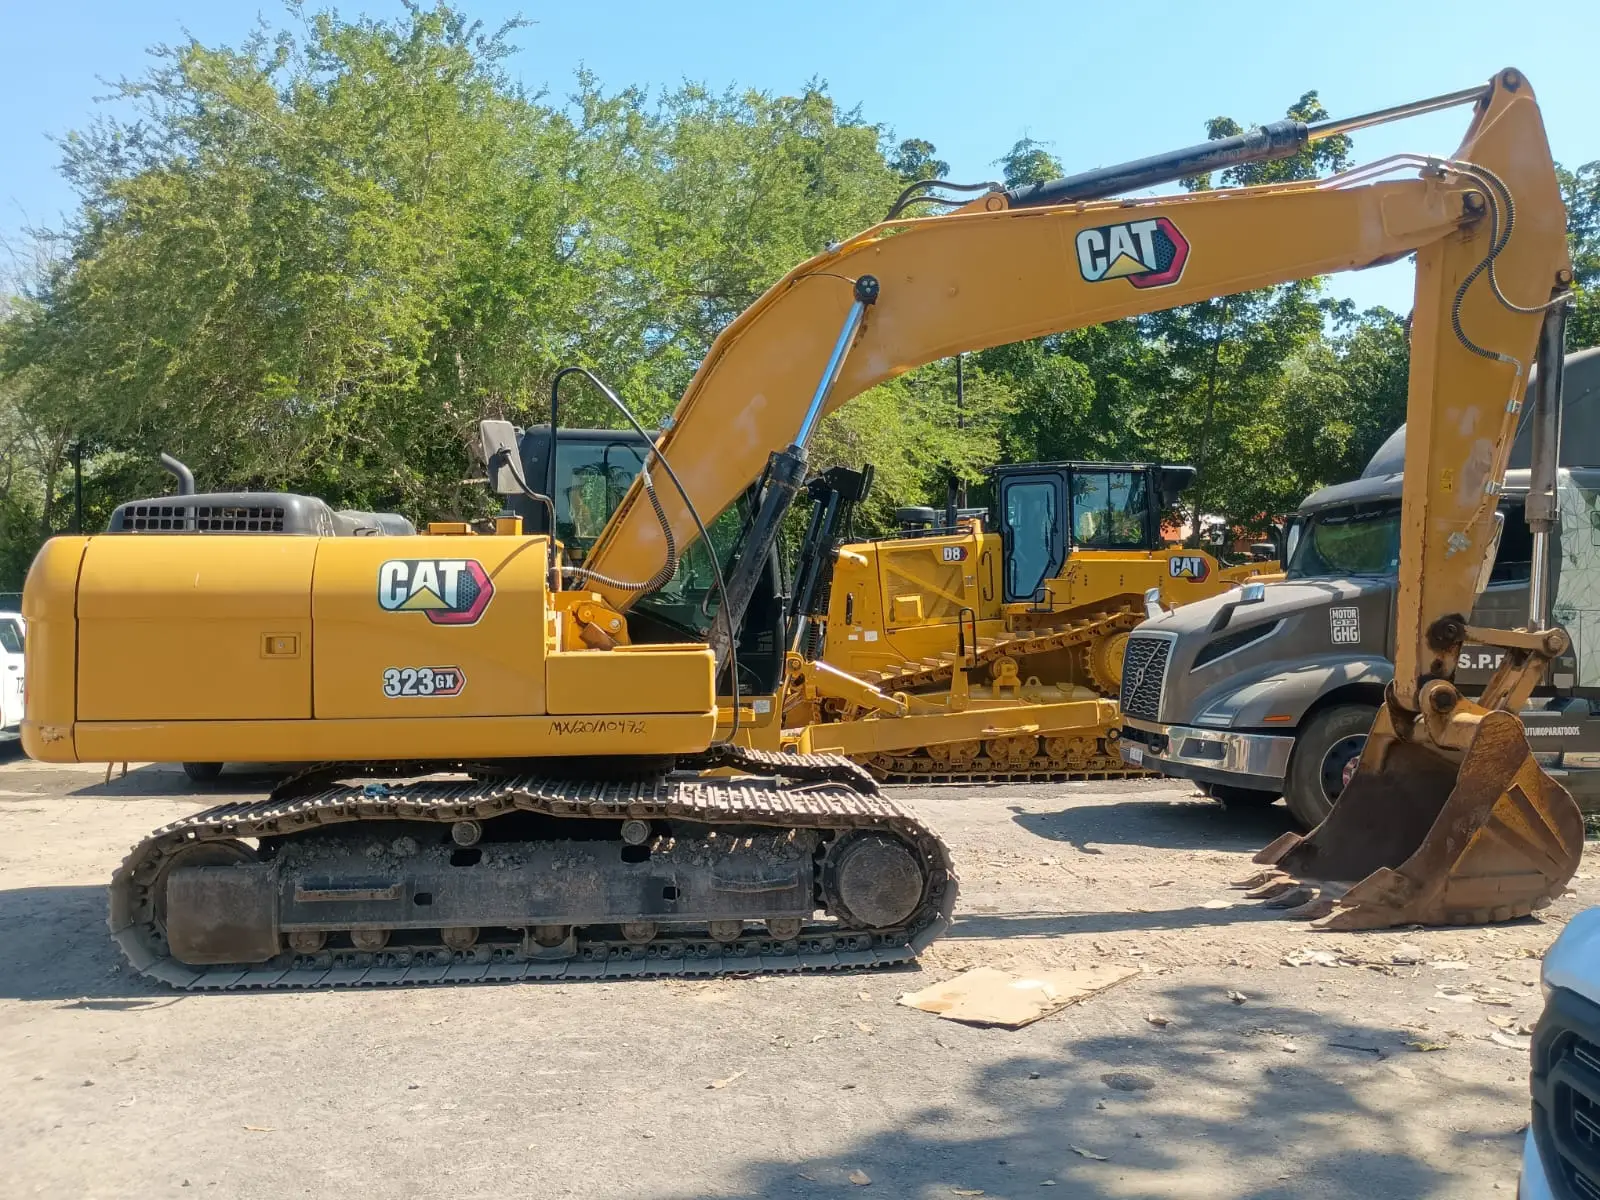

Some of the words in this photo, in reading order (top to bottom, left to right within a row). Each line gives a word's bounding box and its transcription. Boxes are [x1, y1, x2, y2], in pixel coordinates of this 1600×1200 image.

[1077, 220, 1157, 281] CAT
[943, 547, 960, 561] D8
[1170, 557, 1200, 577] CAT
[380, 561, 467, 610] CAT
[1332, 609, 1356, 619] MOTOR
[1333, 627, 1358, 641] GHG
[1524, 726, 1580, 737] UTUROPARATODOS
